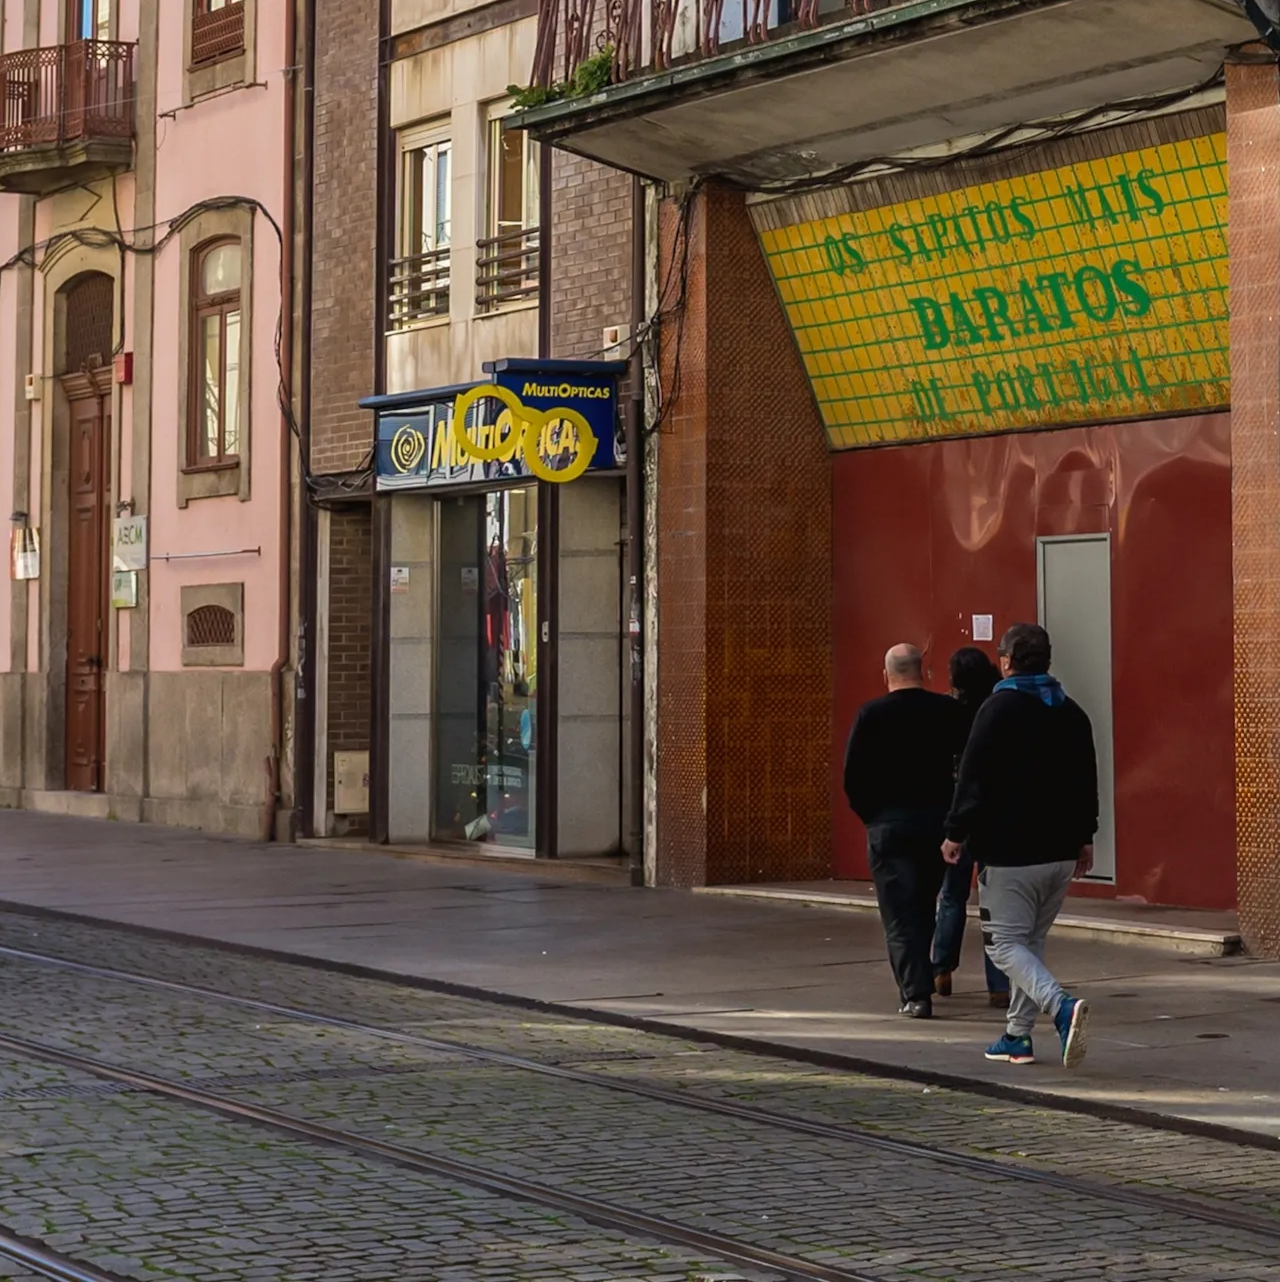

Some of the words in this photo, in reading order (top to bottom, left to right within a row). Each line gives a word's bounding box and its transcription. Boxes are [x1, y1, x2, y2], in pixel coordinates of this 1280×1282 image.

[824, 232, 866, 276] OS
[1065, 168, 1165, 232] MAIS
[909, 259, 1151, 350] BARATOS
